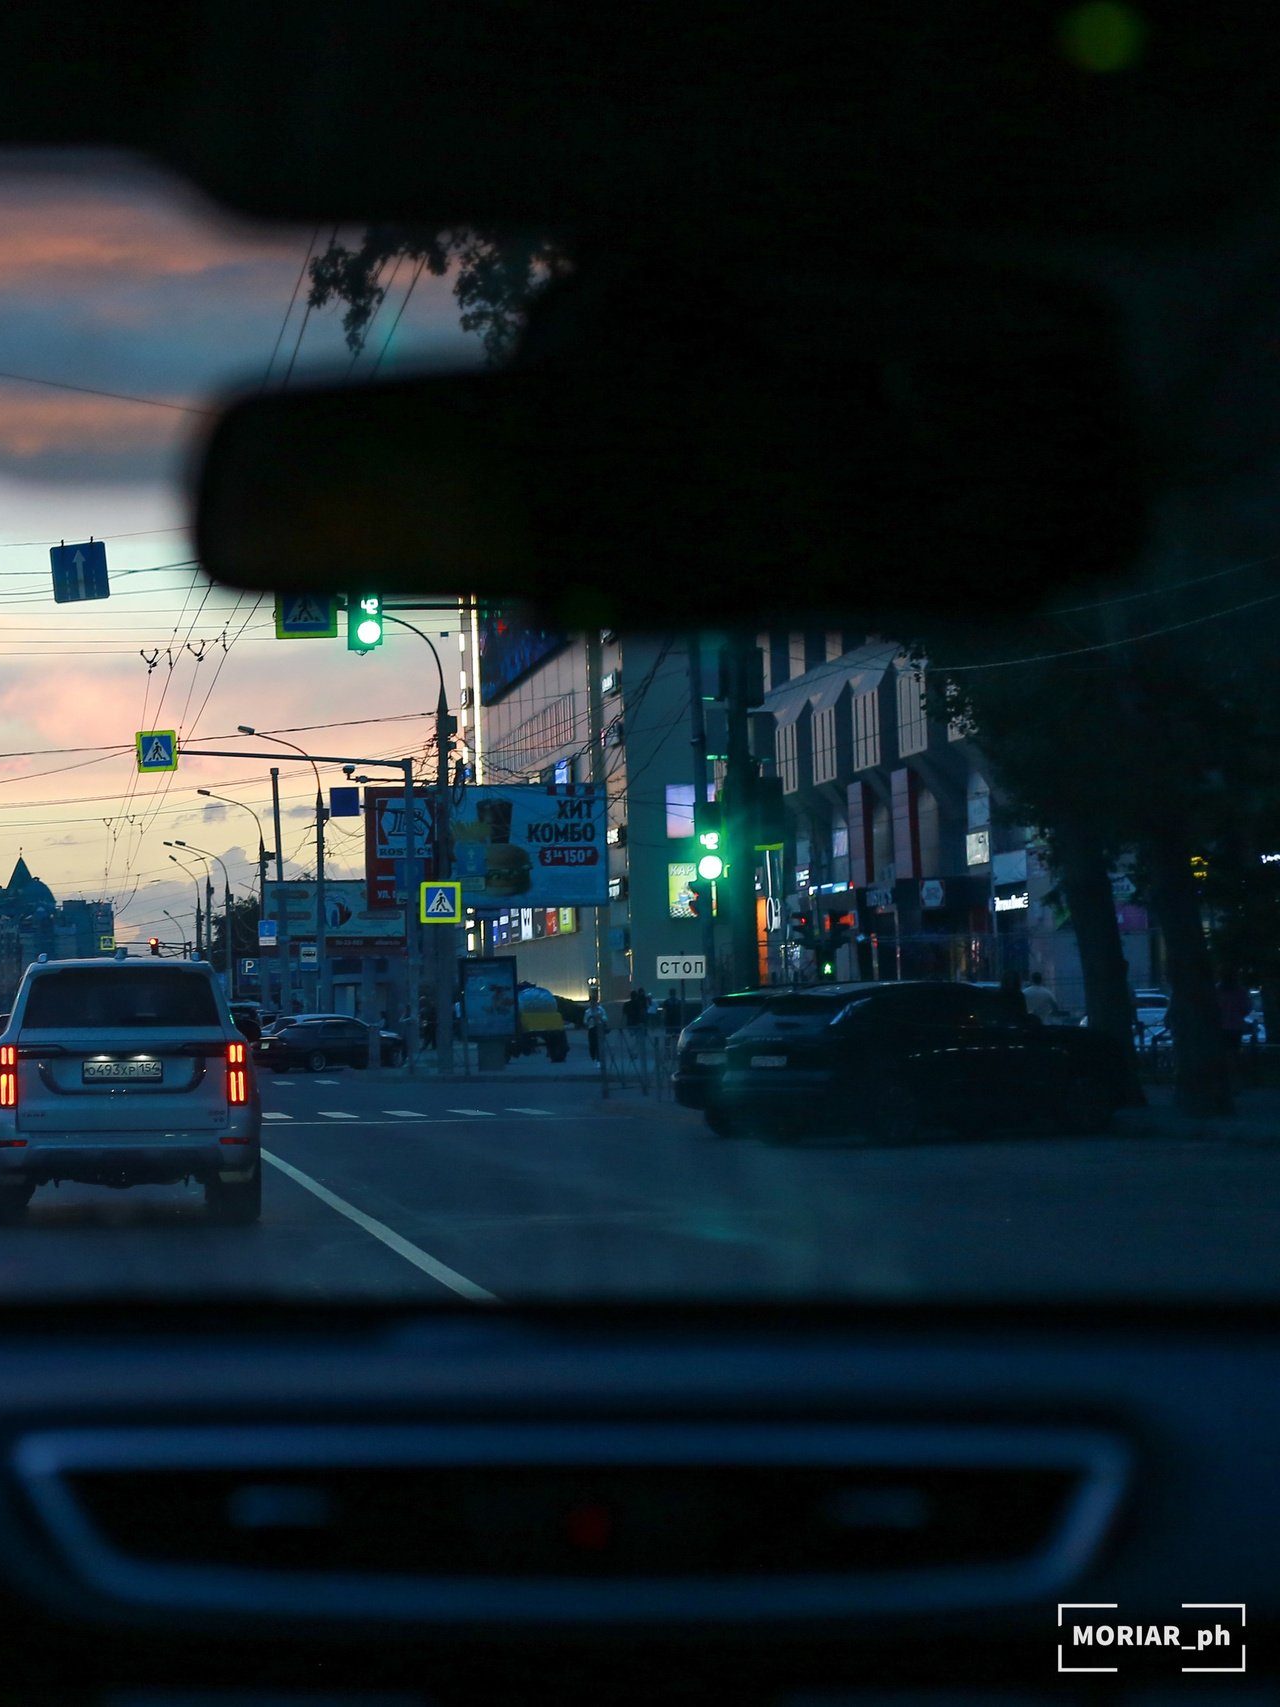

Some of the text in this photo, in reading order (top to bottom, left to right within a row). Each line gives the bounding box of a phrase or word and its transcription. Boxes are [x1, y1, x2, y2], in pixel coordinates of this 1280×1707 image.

[557, 800, 595, 819] ХИТ
[526, 823, 595, 842] КОМБО
[245, 960, 254, 973] P
[660, 961, 703, 974] СТОП
